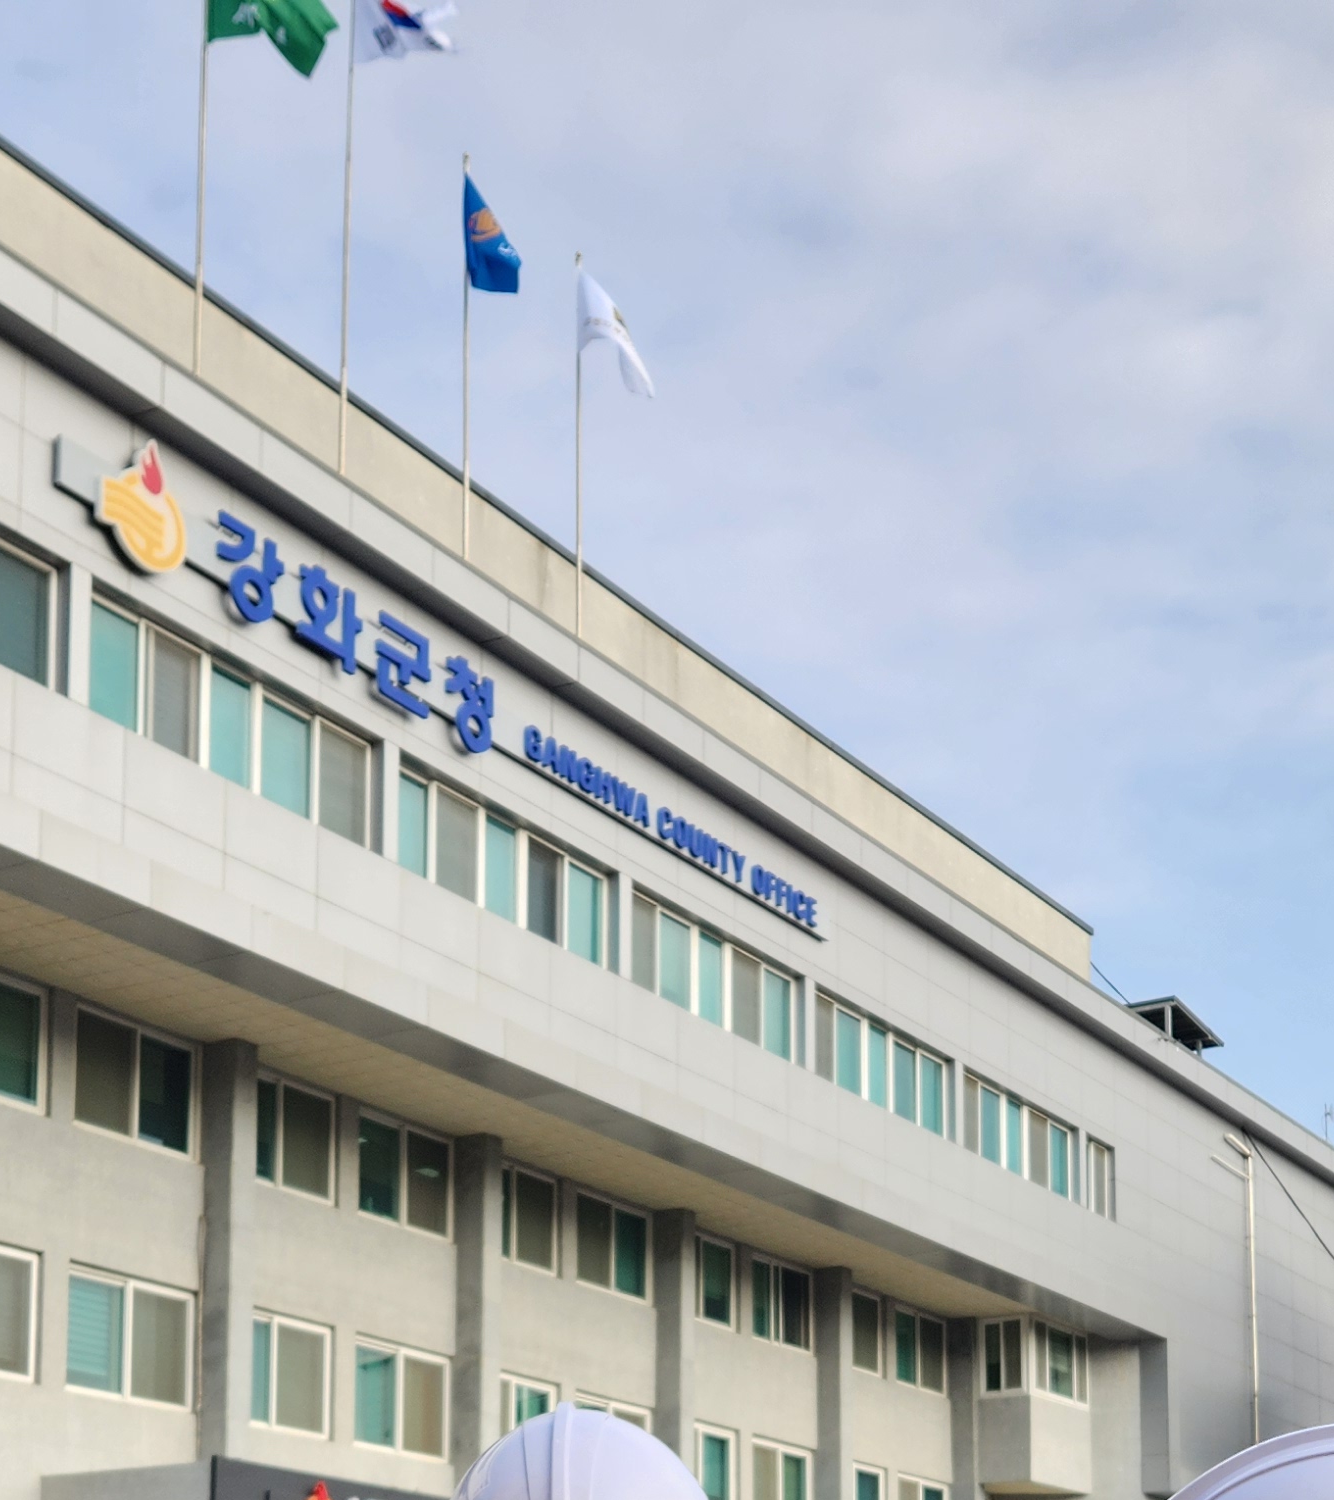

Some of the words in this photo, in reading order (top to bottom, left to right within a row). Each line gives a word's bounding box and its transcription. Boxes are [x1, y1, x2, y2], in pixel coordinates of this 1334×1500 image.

[216, 510, 494, 754] 강화군청
[523, 724, 650, 828] GANGHWA
[656, 806, 747, 884] COUNTY
[750, 863, 818, 928] OFFICE
